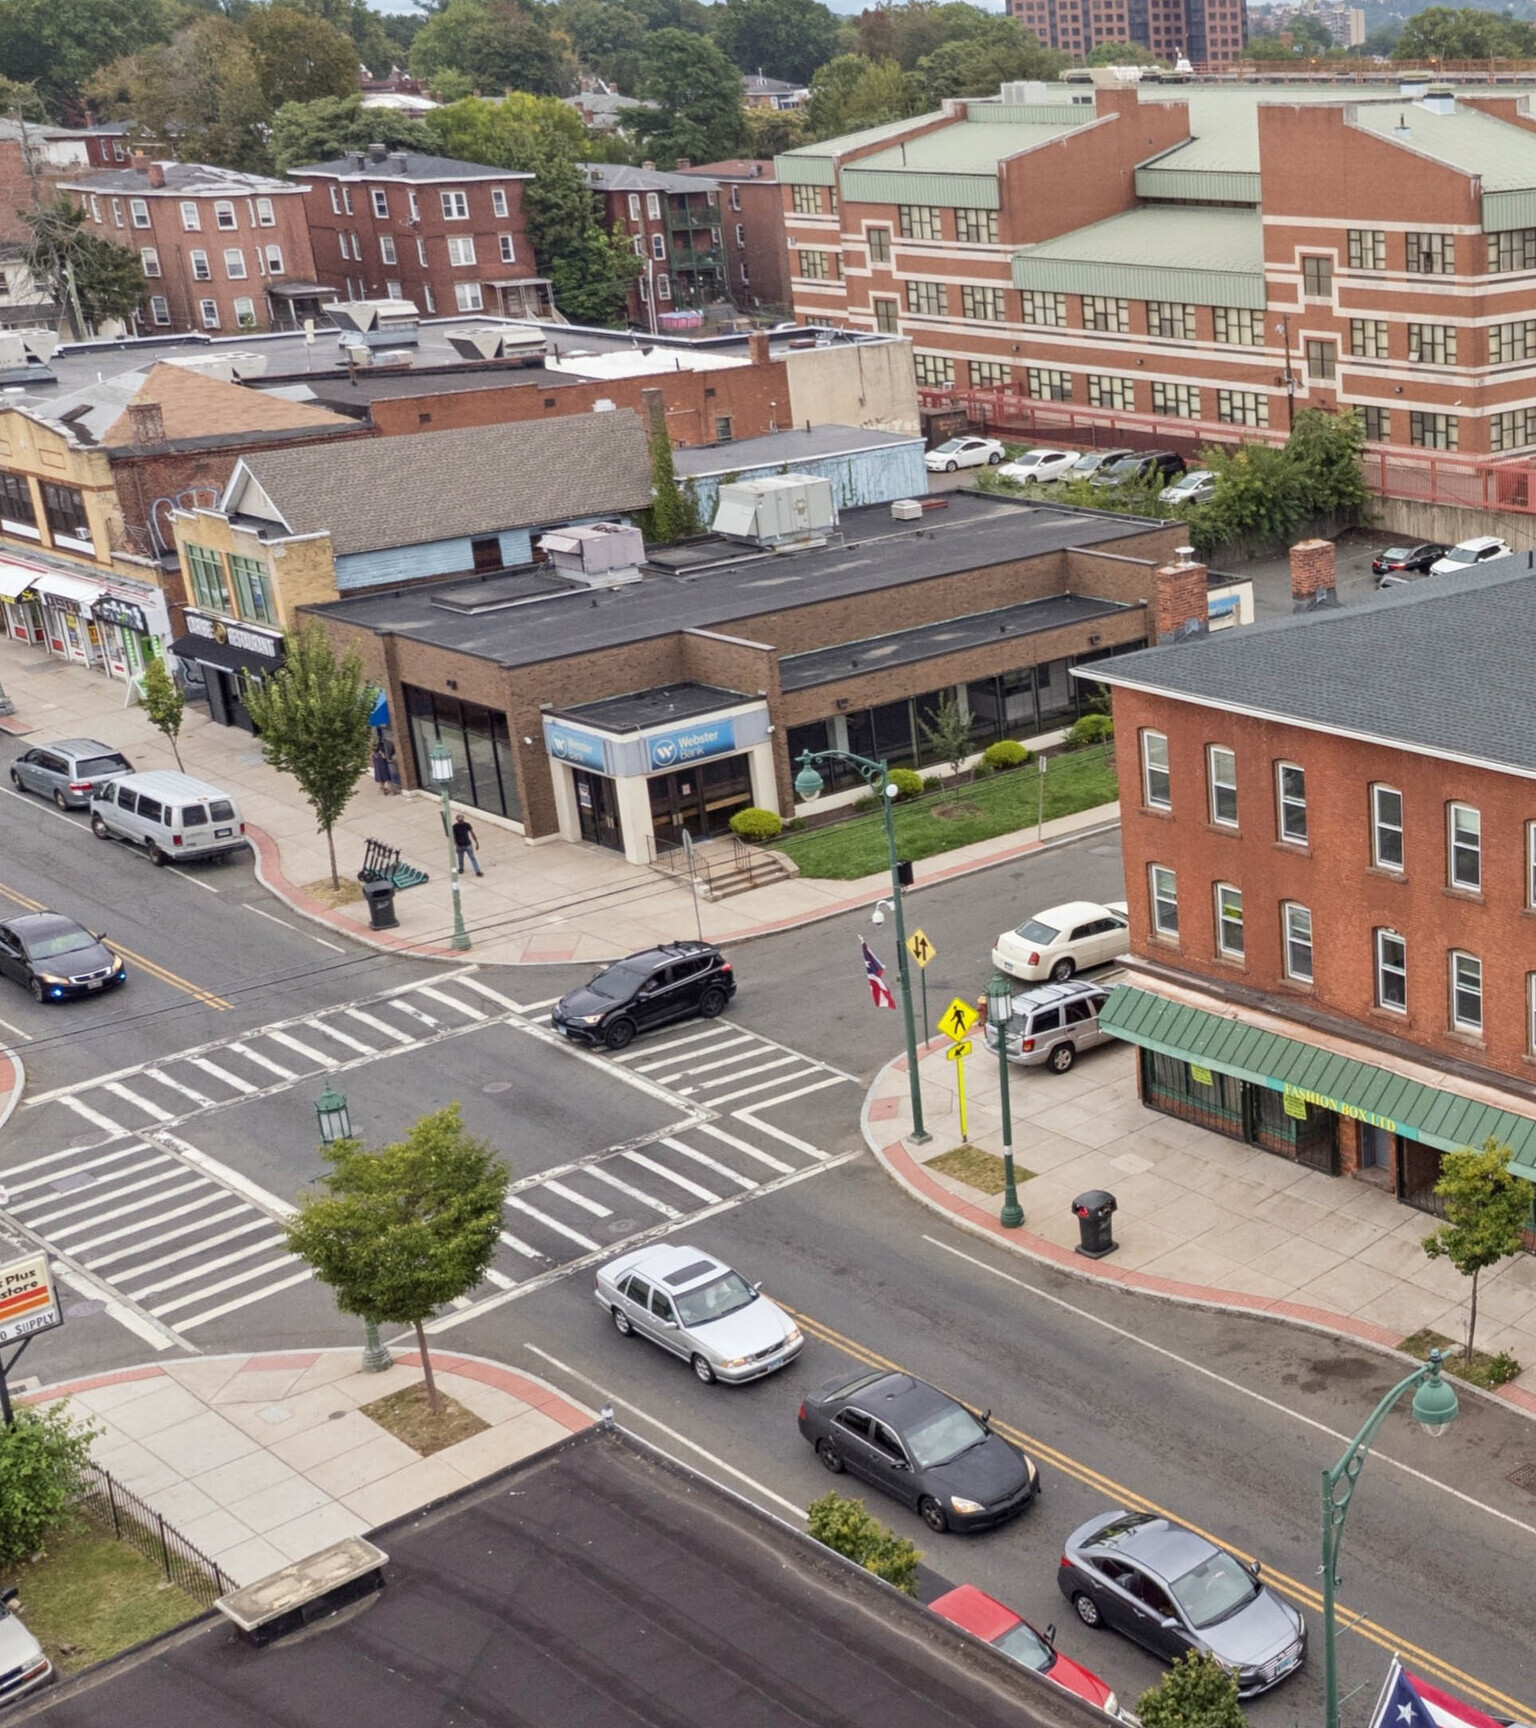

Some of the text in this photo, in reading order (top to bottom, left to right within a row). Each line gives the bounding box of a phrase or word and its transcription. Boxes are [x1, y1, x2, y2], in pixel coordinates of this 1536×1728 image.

[677, 731, 718, 749] Webster
[680, 745, 704, 760] Bank
[1285, 1083, 1337, 1110] FASHION
[1341, 1104, 1367, 1122] BOX
[1370, 1114, 1396, 1132] LTD
[5, 1269, 37, 1286] Plus
[0, 1281, 38, 1299] store
[15, 1312, 54, 1335] SUPPLY
